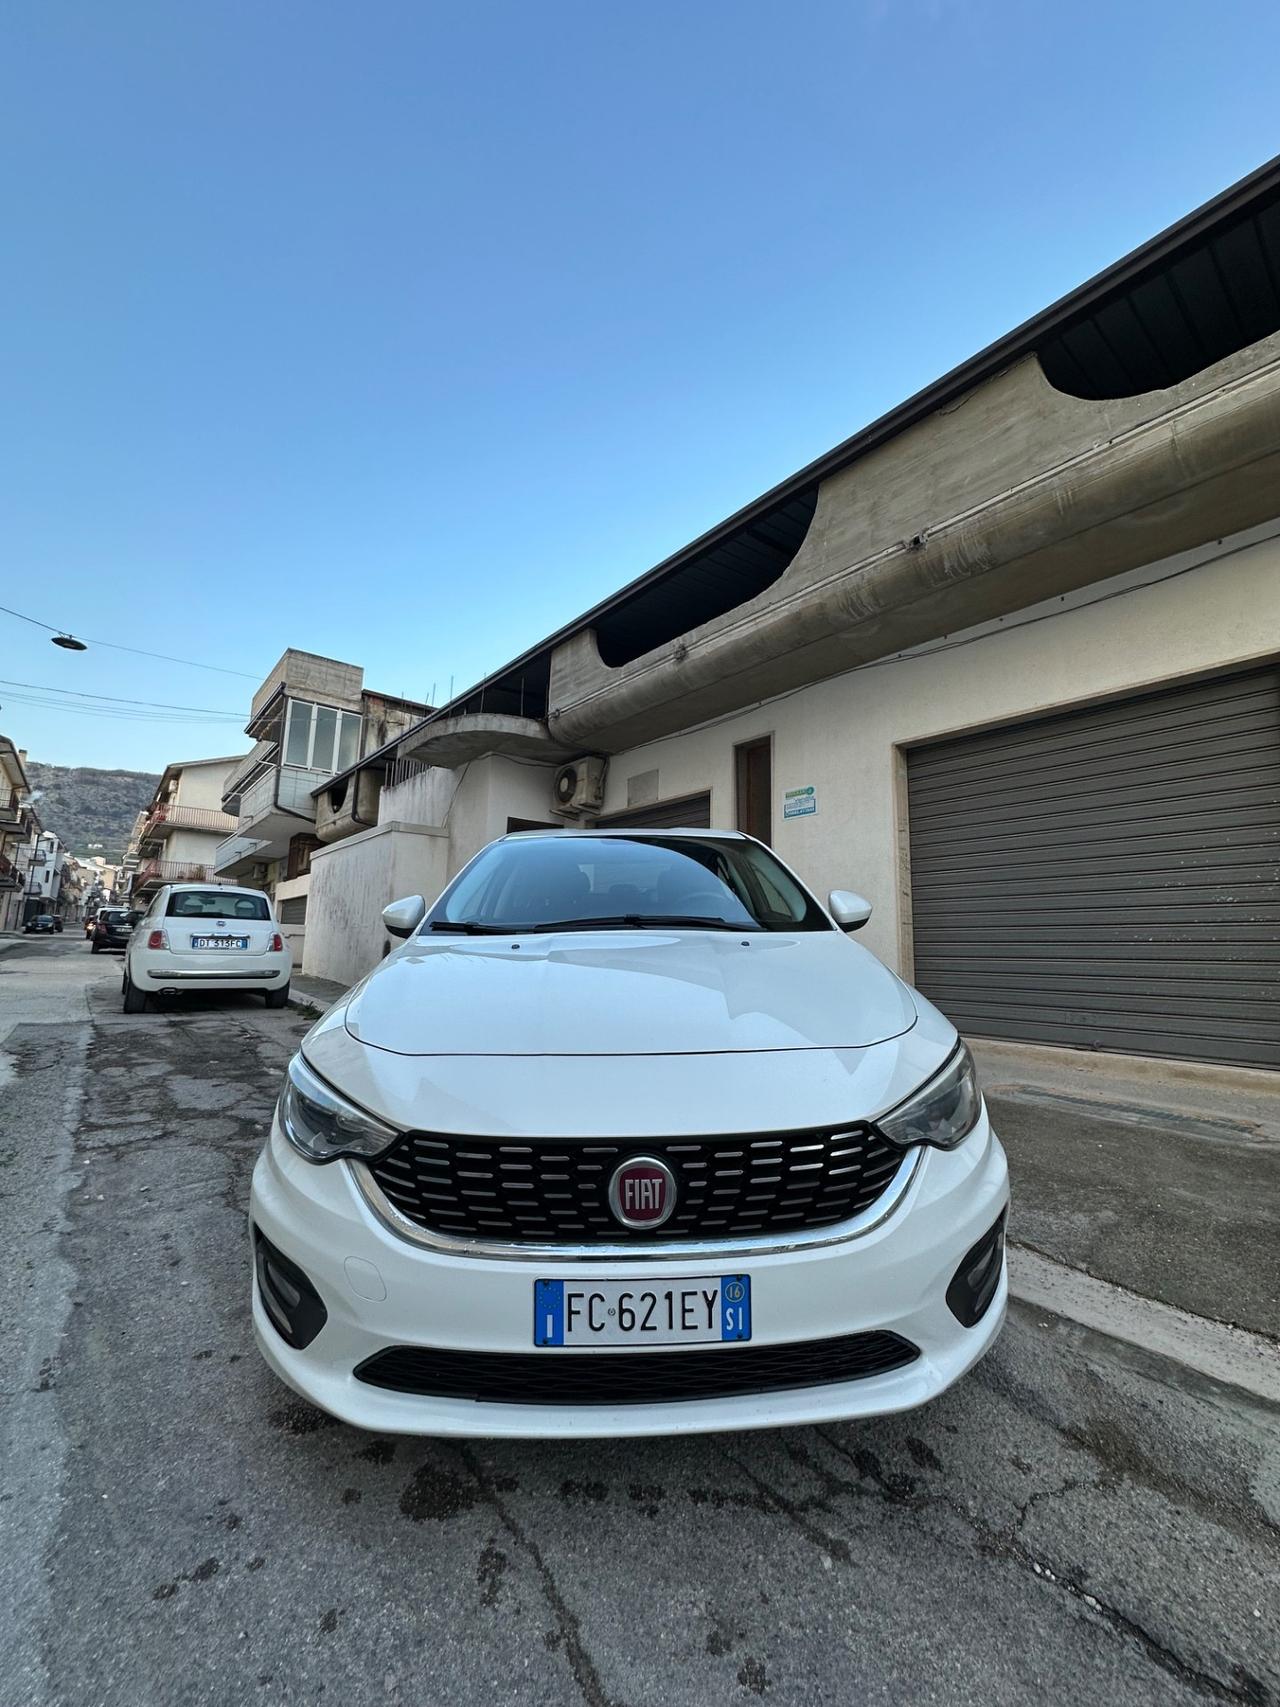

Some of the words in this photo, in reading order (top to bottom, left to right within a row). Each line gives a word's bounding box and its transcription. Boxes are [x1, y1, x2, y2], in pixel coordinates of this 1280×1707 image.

[624, 1178, 663, 1210] FIAT
[728, 1284, 741, 1298] 16
[546, 1314, 553, 1338] I
[726, 1306, 743, 1331] SI
